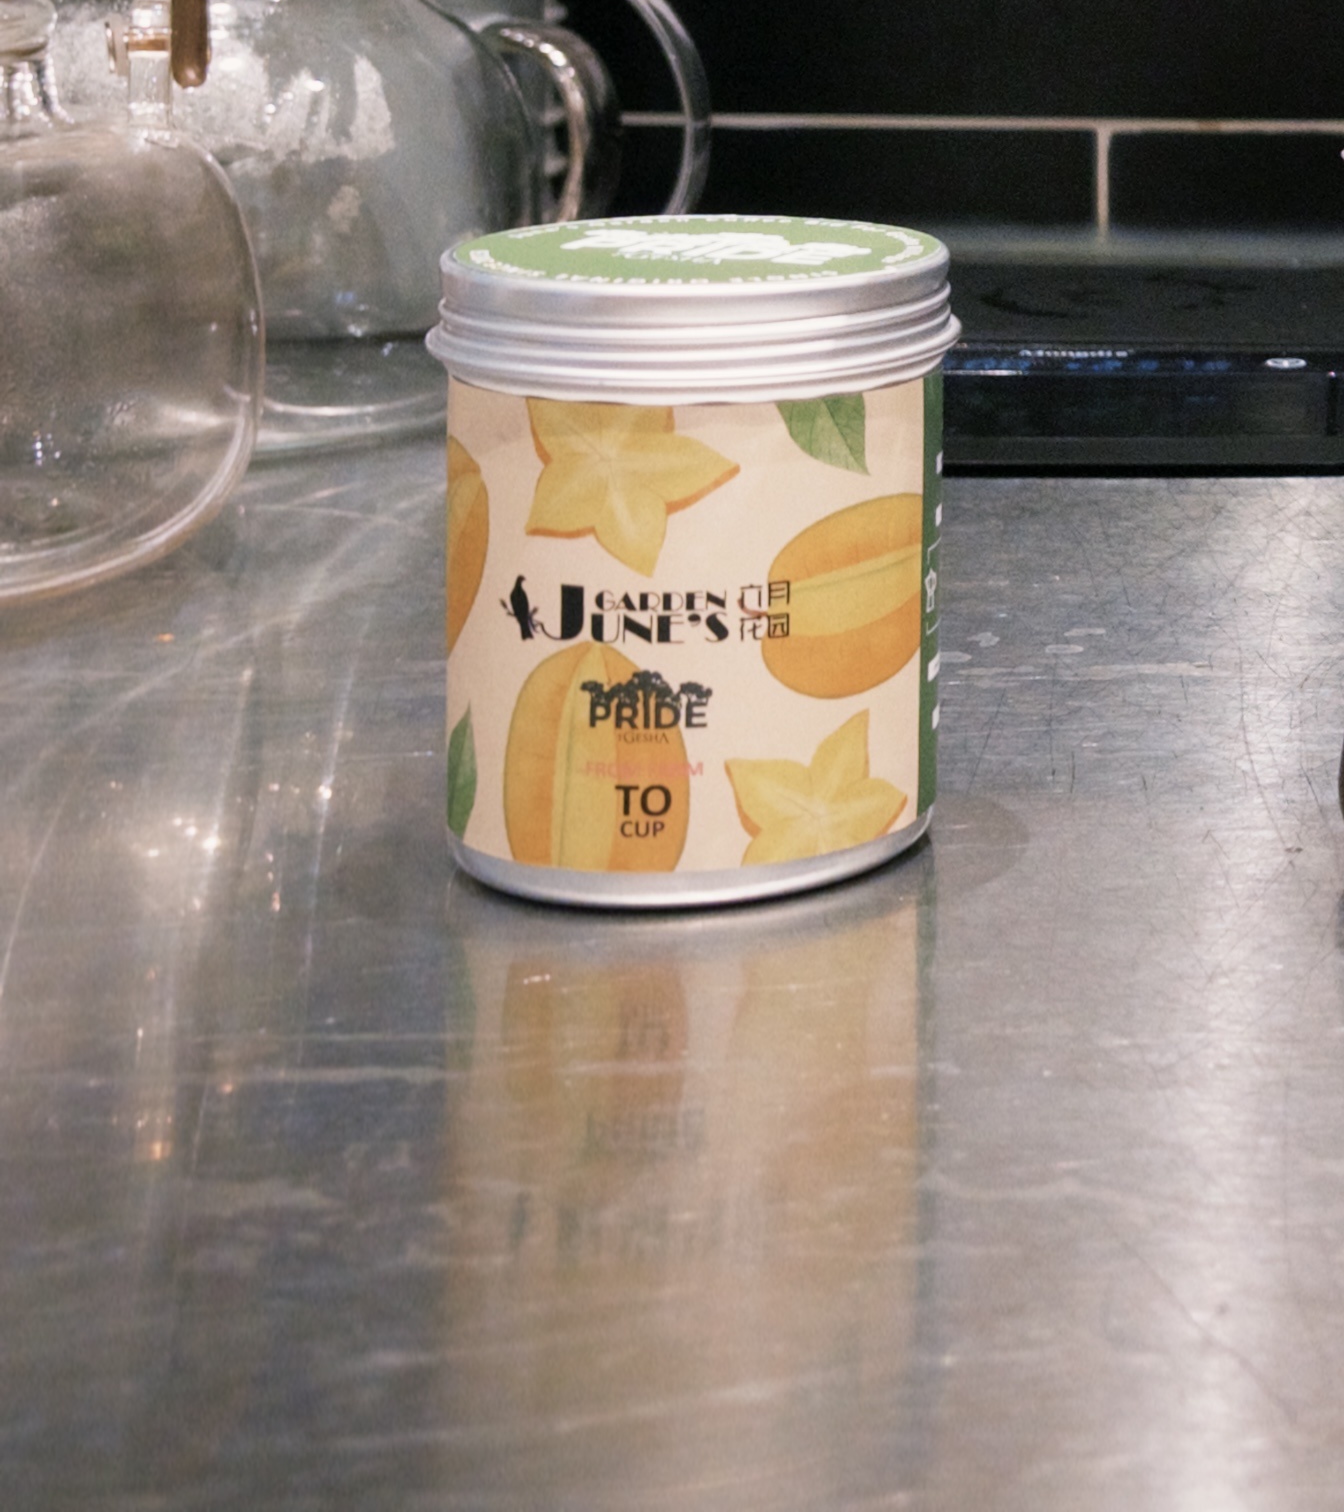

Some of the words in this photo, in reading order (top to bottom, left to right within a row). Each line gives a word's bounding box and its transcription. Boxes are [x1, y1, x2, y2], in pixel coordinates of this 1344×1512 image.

[560, 228, 873, 267] PRIDE
[538, 584, 730, 644] JUNE'S
[594, 589, 728, 612] GARDEN
[586, 682, 711, 730] PRIDE
[615, 784, 672, 817] TO
[620, 820, 665, 838] CUP
